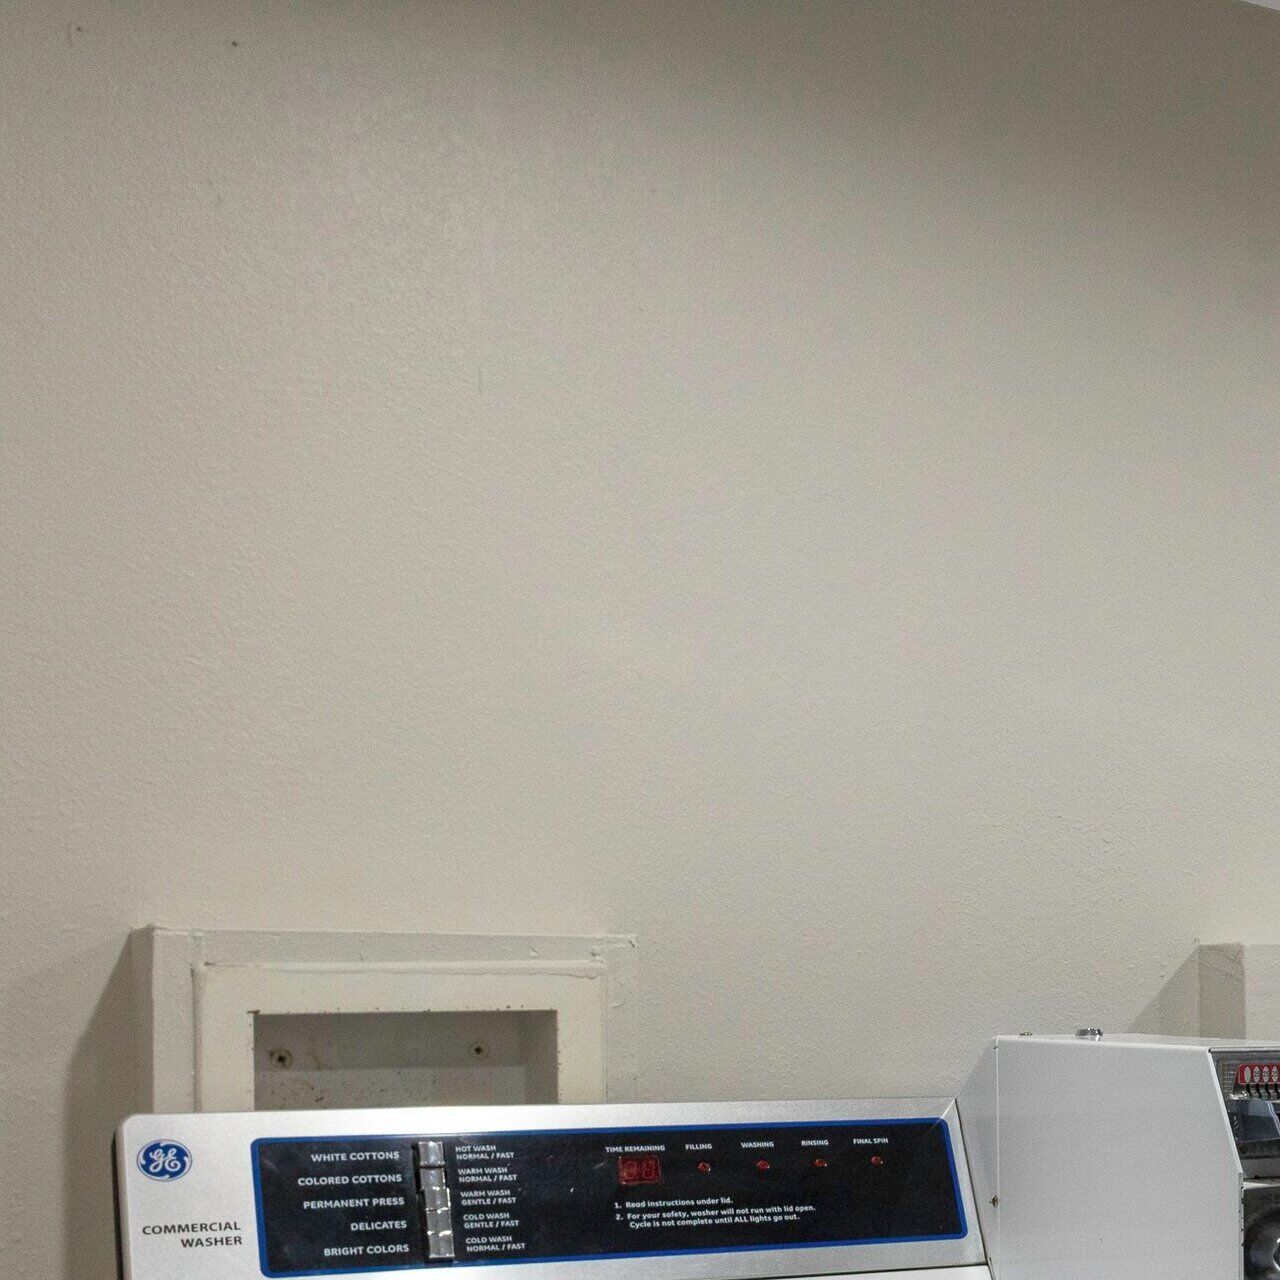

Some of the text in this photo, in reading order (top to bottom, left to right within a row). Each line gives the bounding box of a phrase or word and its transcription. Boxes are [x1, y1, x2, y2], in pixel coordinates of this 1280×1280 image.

[685, 1142, 713, 1150] FILLING
[872, 1136, 889, 1144] SPIN
[624, 1144, 666, 1152] REMAINING
[310, 1150, 400, 1162] WHITE COTTONS
[298, 1174, 402, 1186] COLORED COTTONS
[302, 1196, 406, 1210] PERMANENT PRESS
[625, 1200, 646, 1208] Read
[647, 1199, 695, 1208] instructions
[696, 1198, 720, 1206] under
[720, 1196, 734, 1204] lid.
[642, 1212, 662, 1222] your
[662, 1210, 690, 1220] safety,
[690, 1209, 720, 1218] washer
[720, 1207, 734, 1216] will
[794, 1204, 816, 1214] open.
[350, 1220, 408, 1232] DELICATES
[630, 1220, 651, 1230] Cycle
[676, 1218, 713, 1228] complete
[714, 1216, 733, 1224] until
[750, 1214, 772, 1224] lights
[142, 1221, 242, 1236] COMMERCIAL
[180, 1236, 243, 1248] WASHER
[466, 1236, 488, 1244] COLD
[324, 1244, 410, 1256] BRIGHT COLORS
[466, 1244, 500, 1252] NORMAL
